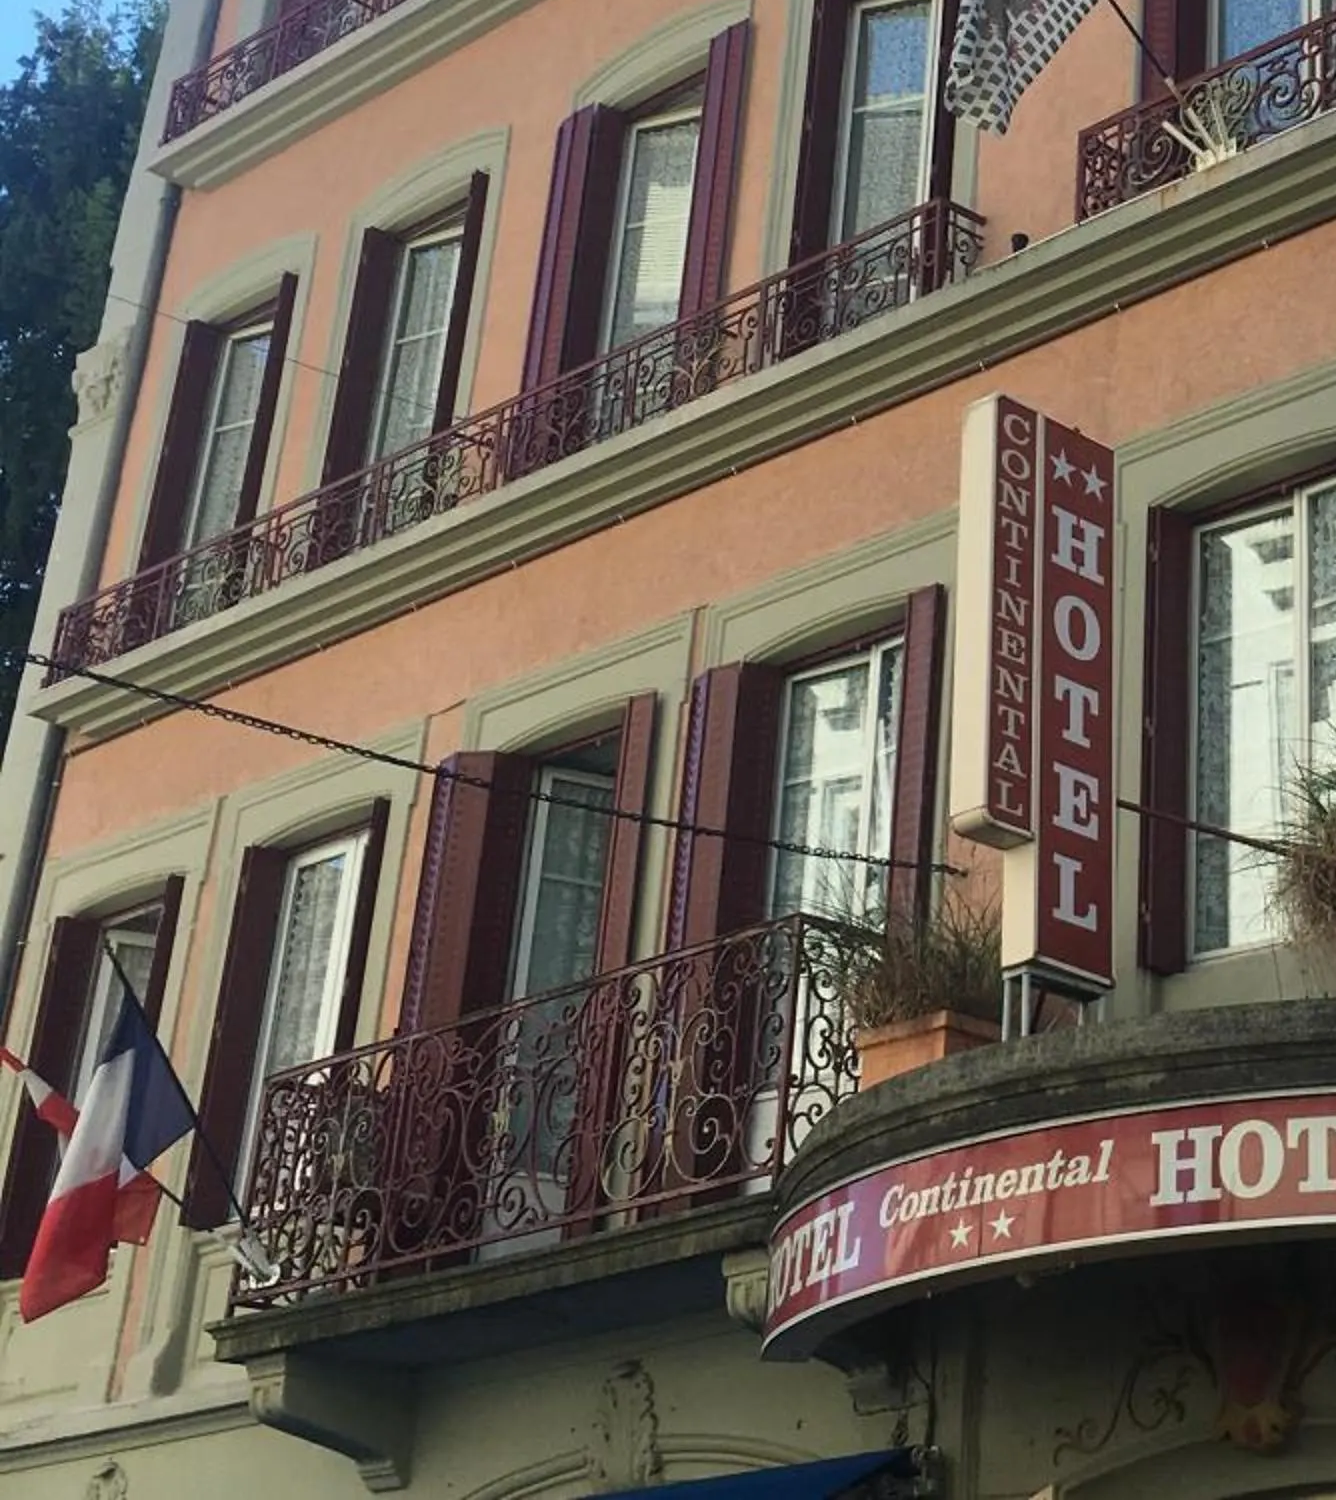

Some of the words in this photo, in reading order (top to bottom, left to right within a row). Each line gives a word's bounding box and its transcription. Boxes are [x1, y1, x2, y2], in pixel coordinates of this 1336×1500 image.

[993, 412, 1031, 817] CONTINENTAL
[1050, 504, 1104, 931] HOTEL
[878, 1140, 1112, 1229] Continental
